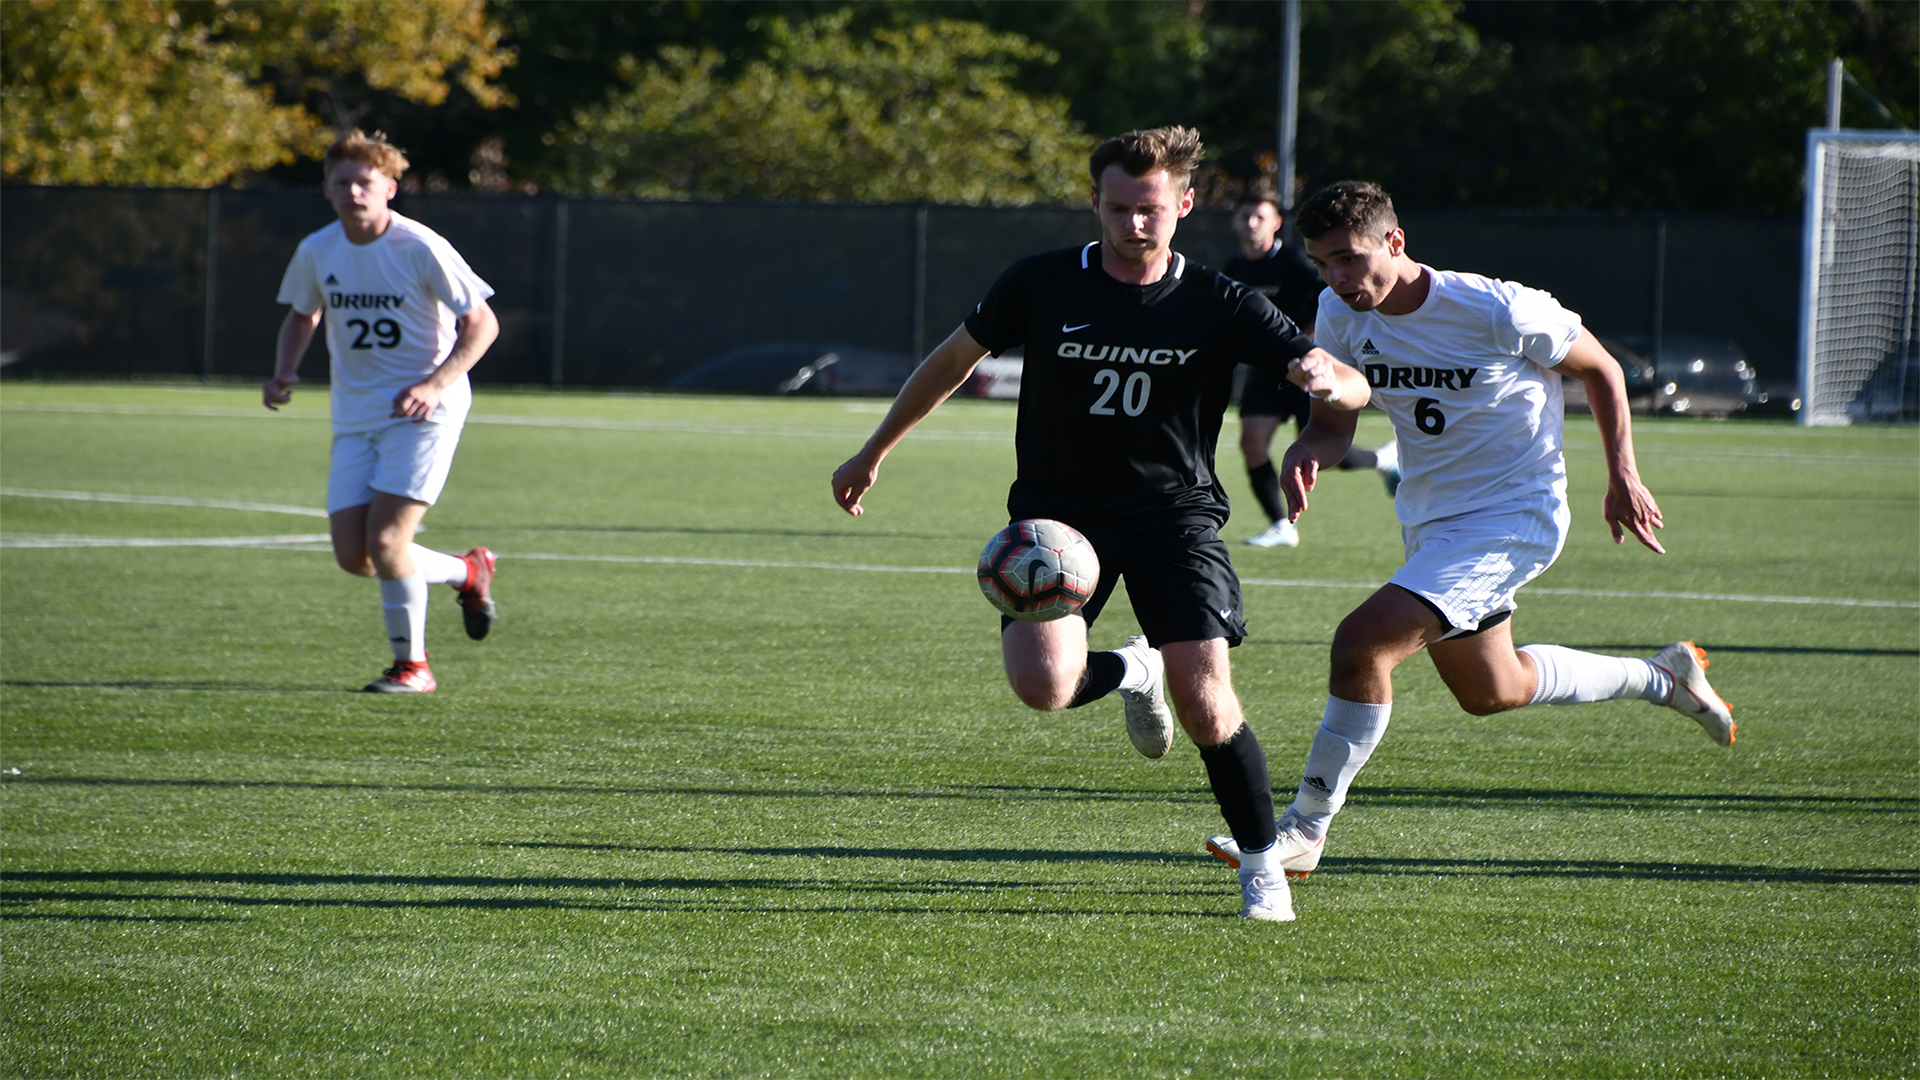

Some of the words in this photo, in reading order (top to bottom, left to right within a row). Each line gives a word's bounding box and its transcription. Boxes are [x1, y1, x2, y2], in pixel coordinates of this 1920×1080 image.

[330, 292, 405, 310] DRURY
[346, 318, 402, 350] 29
[1057, 342, 1199, 365] QUINCY
[1364, 363, 1479, 391] DRURY
[1089, 368, 1152, 417] 20
[1414, 397, 1446, 436] 6
